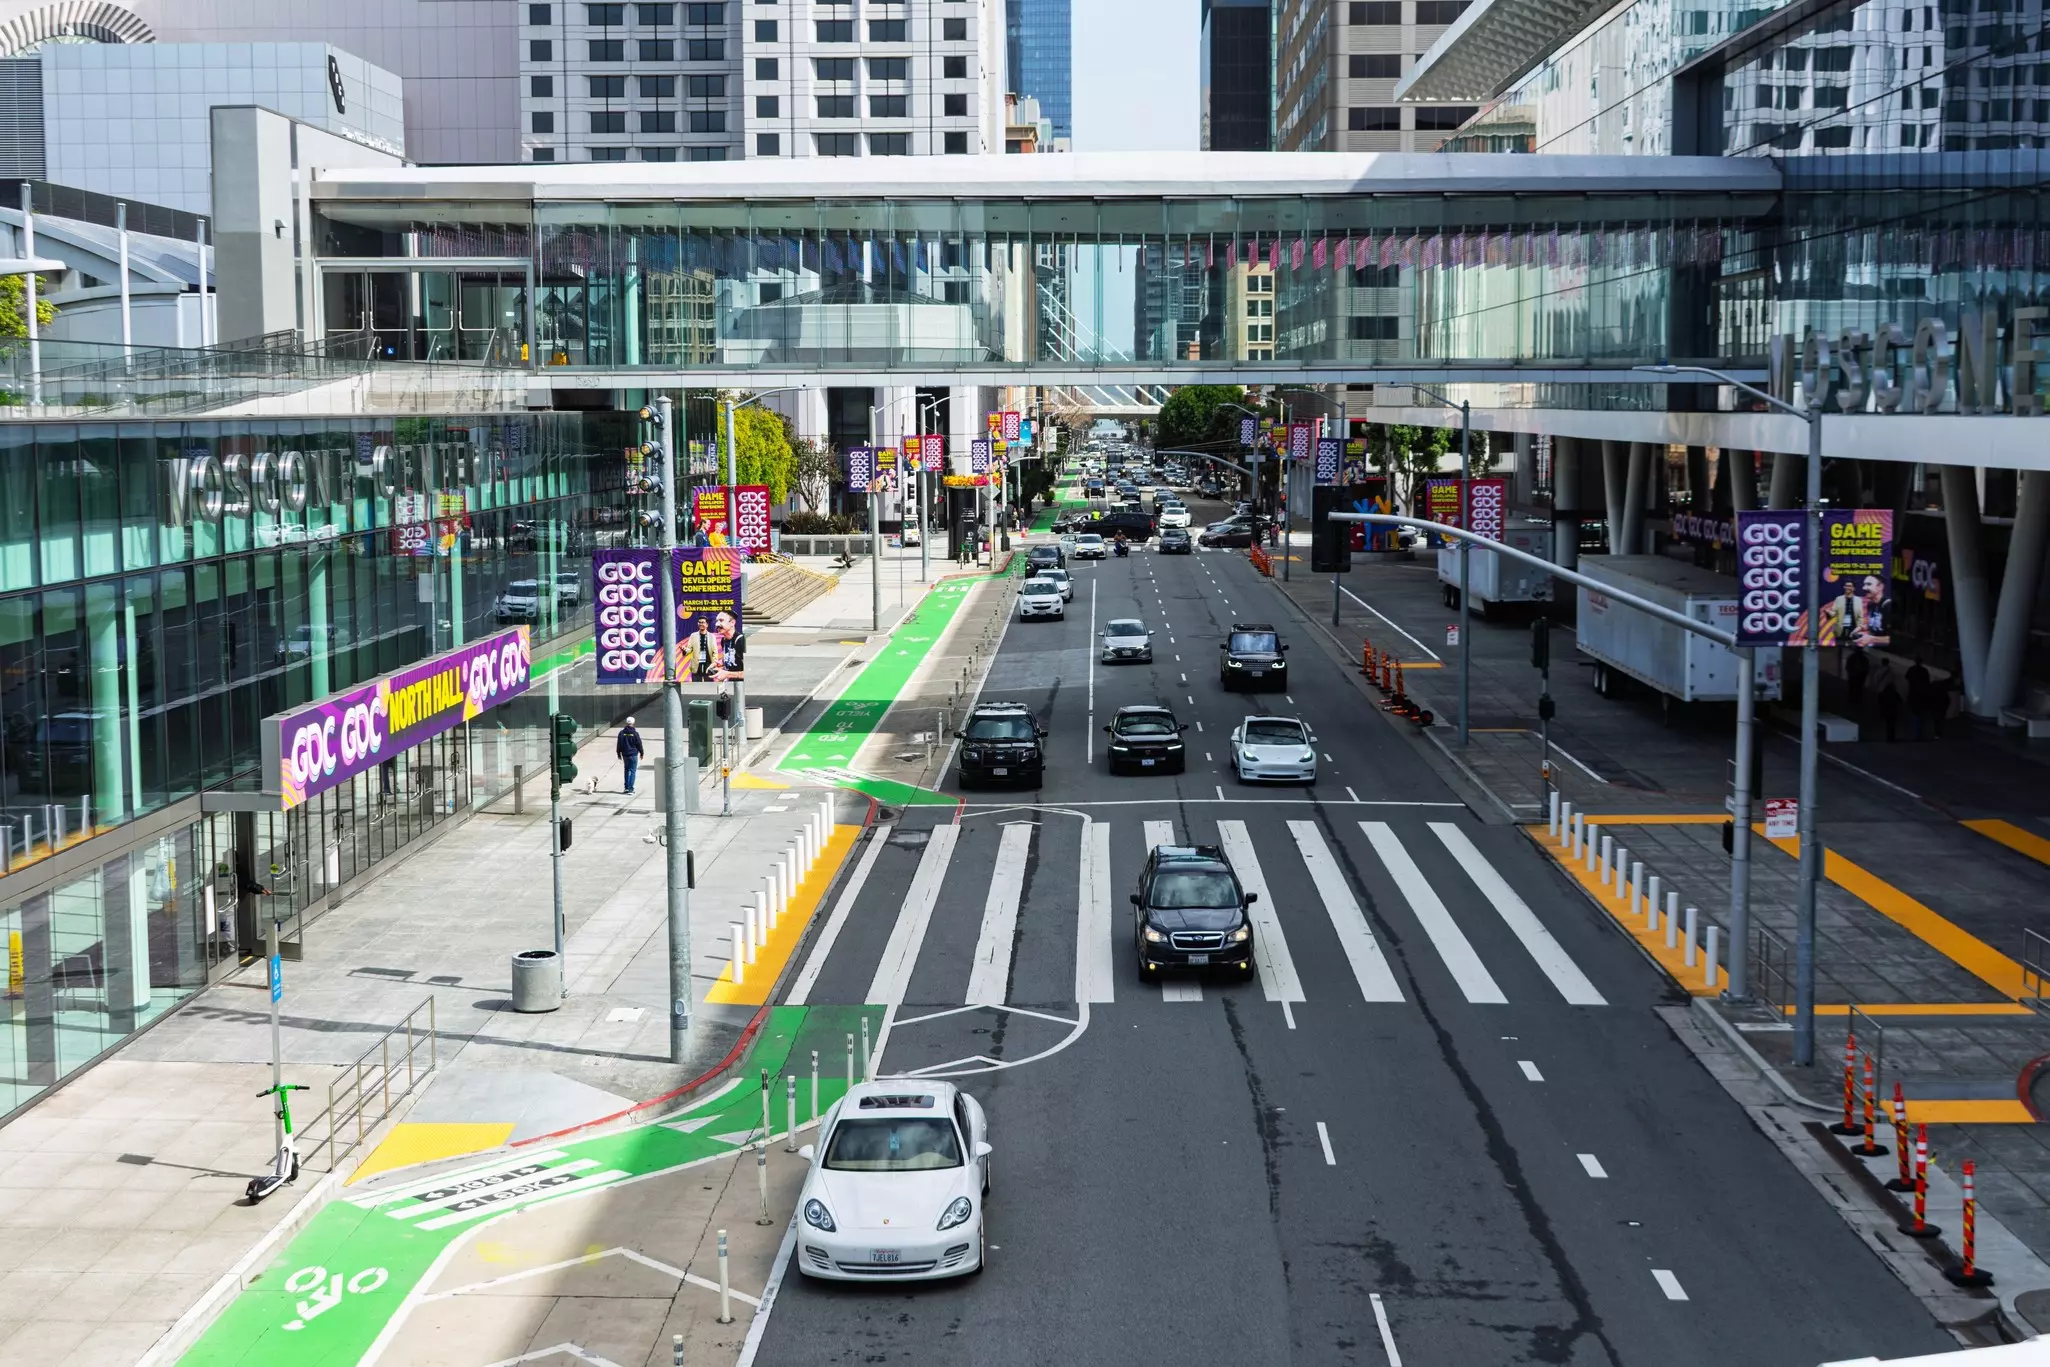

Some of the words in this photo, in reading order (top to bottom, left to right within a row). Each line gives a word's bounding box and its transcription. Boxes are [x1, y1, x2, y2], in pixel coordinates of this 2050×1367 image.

[1768, 306, 2049, 417] MOSCONE
[156, 449, 352, 528] MOSCONE
[699, 492, 724, 500] GAME
[738, 492, 766, 502] GDC
[1472, 486, 1501, 496] GDC
[739, 503, 766, 514] GDC
[1472, 497, 1501, 507] GDC
[739, 514, 767, 525] GDC
[1472, 508, 1501, 518] GDC
[739, 526, 767, 536] GDC
[1472, 520, 1501, 530] GDC
[1743, 523, 1800, 545] GDC
[1831, 523, 1882, 538] GAME
[740, 537, 767, 548] GDC
[1743, 545, 1800, 567] GDC
[599, 562, 653, 583] GDC
[682, 560, 731, 576] GAME
[1743, 567, 1800, 589] GDC
[600, 583, 654, 605] GDC
[1743, 589, 1800, 611] GDC
[600, 605, 655, 627] GDC
[1743, 612, 1800, 634] GDC
[601, 627, 656, 649] GDC
[602, 649, 657, 671] GDC
[291, 716, 337, 790] GDC
[341, 696, 382, 766] GDC
[389, 678, 432, 735] NORTH
[434, 666, 464, 714] HALL
[470, 649, 498, 705] GDC
[500, 638, 526, 691] GDC
